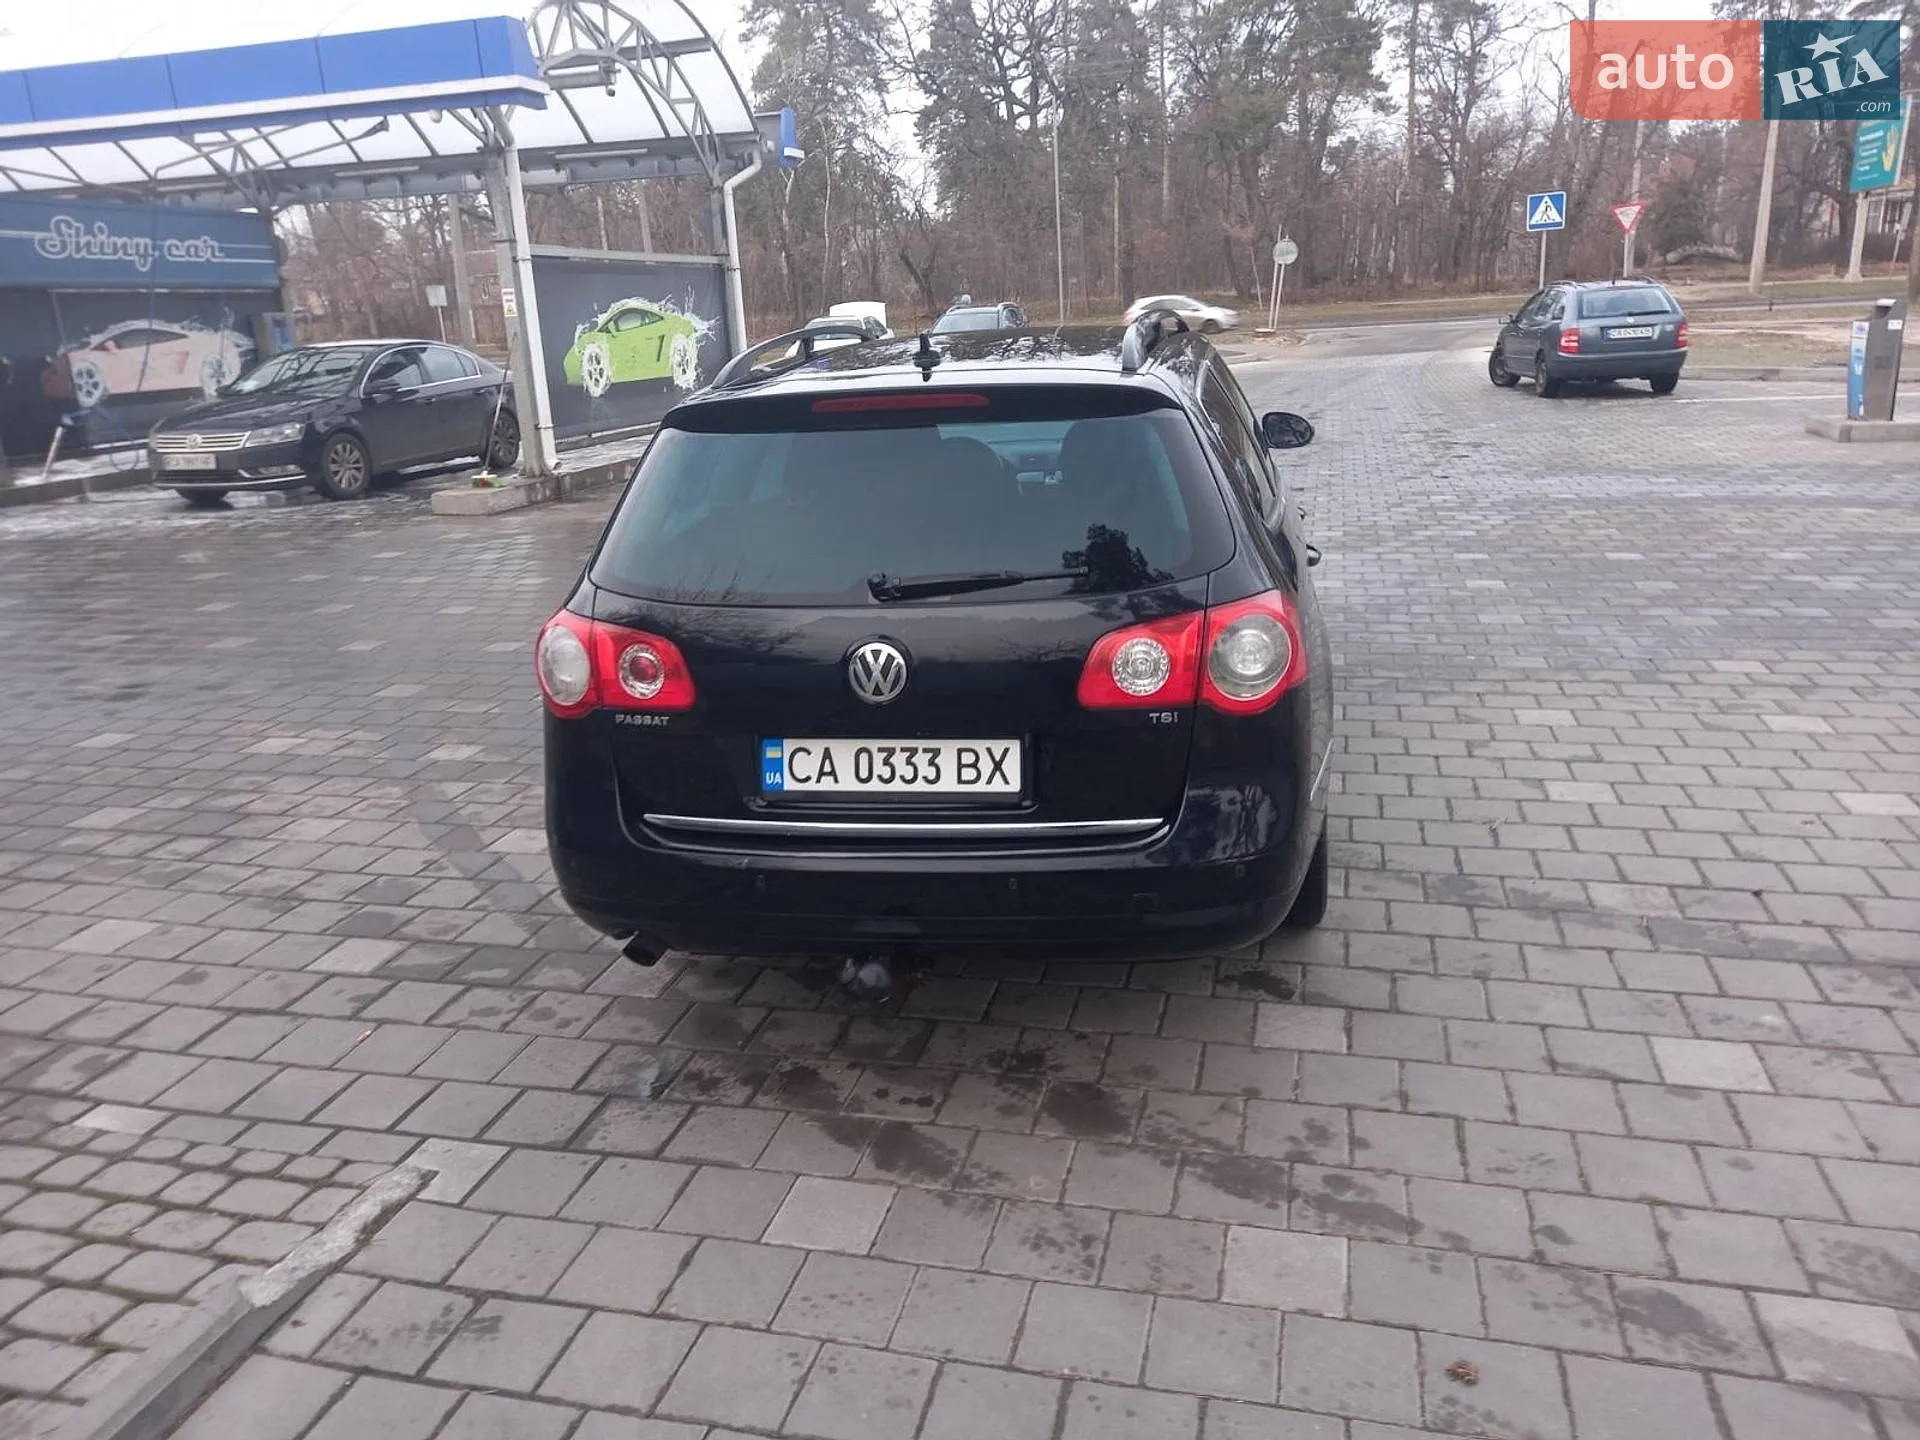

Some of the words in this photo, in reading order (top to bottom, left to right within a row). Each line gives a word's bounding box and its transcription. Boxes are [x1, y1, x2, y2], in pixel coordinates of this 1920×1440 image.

[35, 215, 154, 272] Shiny
[164, 235, 225, 262] car
[615, 714, 670, 726] PASSAT
[766, 772, 782, 784] UA
[788, 746, 839, 785] CA
[854, 746, 942, 785] 0333
[956, 747, 1011, 785] BX
